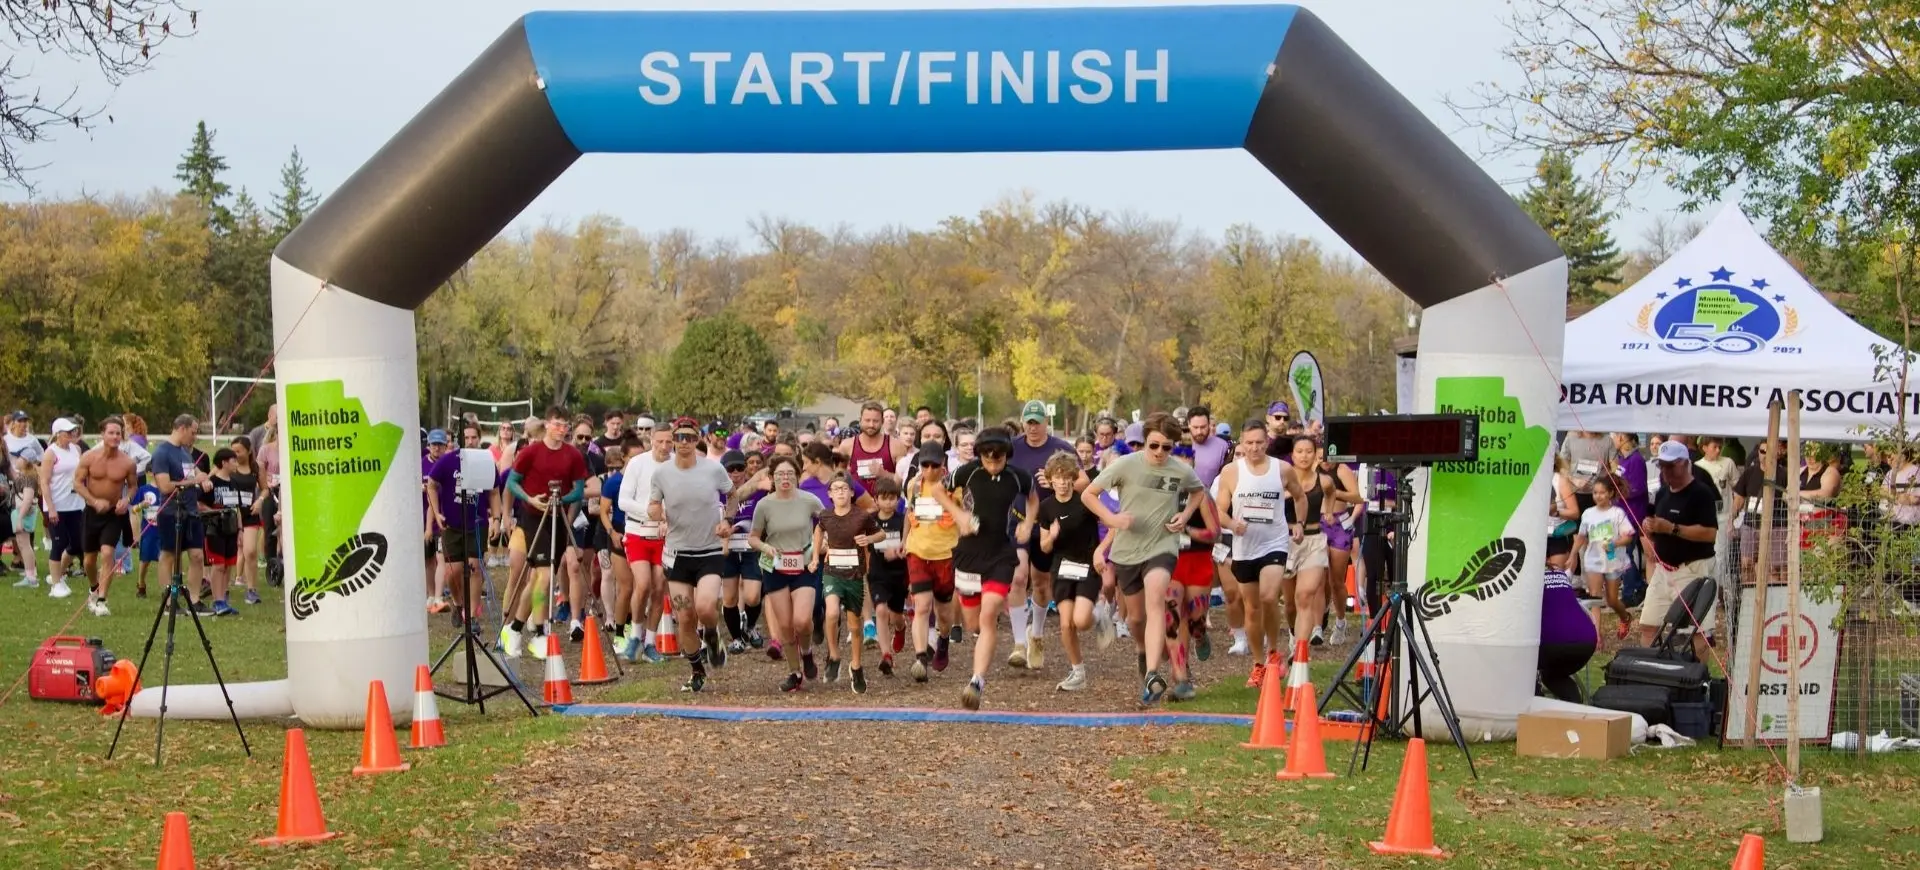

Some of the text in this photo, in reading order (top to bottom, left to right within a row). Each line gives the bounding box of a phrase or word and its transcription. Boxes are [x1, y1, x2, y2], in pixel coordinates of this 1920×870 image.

[638, 48, 1169, 105] START/FINISH
[1772, 346, 1803, 354] 2021
[1615, 383, 1760, 409] RUNNERS'
[291, 408, 359, 427] Manitoba
[292, 432, 358, 452] Runners'
[293, 456, 382, 476] Association
[1437, 458, 1530, 476] Association
[782, 558, 798, 568] 683
